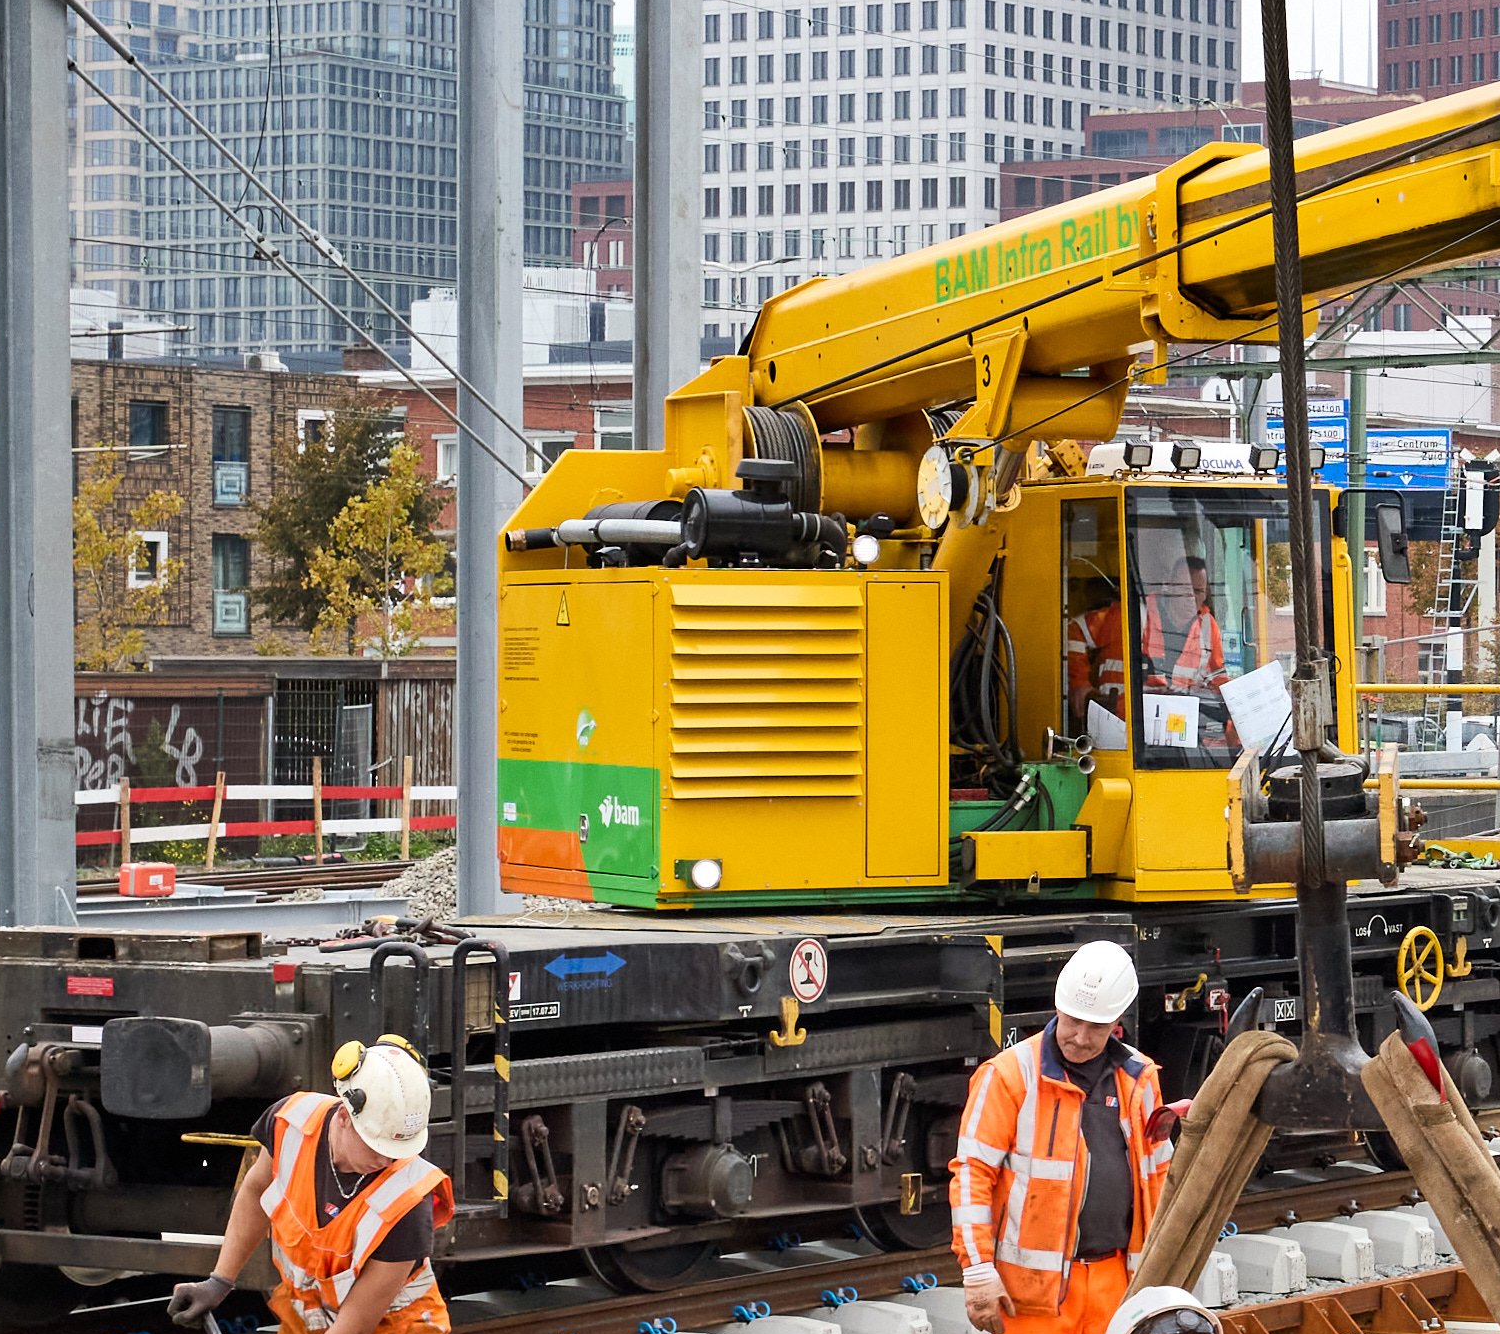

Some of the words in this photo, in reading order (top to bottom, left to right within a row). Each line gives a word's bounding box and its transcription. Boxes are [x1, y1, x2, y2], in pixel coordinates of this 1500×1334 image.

[935, 245, 988, 304] BAM
[997, 232, 1051, 284] Infra
[1061, 207, 1107, 266] Rail
[982, 354, 991, 387] 3
[1307, 403, 1341, 414] Station
[1397, 439, 1438, 449] Centrum
[614, 796, 640, 826] bam
[1356, 927, 1367, 937] LOS
[1387, 924, 1403, 935] VAST
[532, 1005, 557, 1016] 17.07.20
